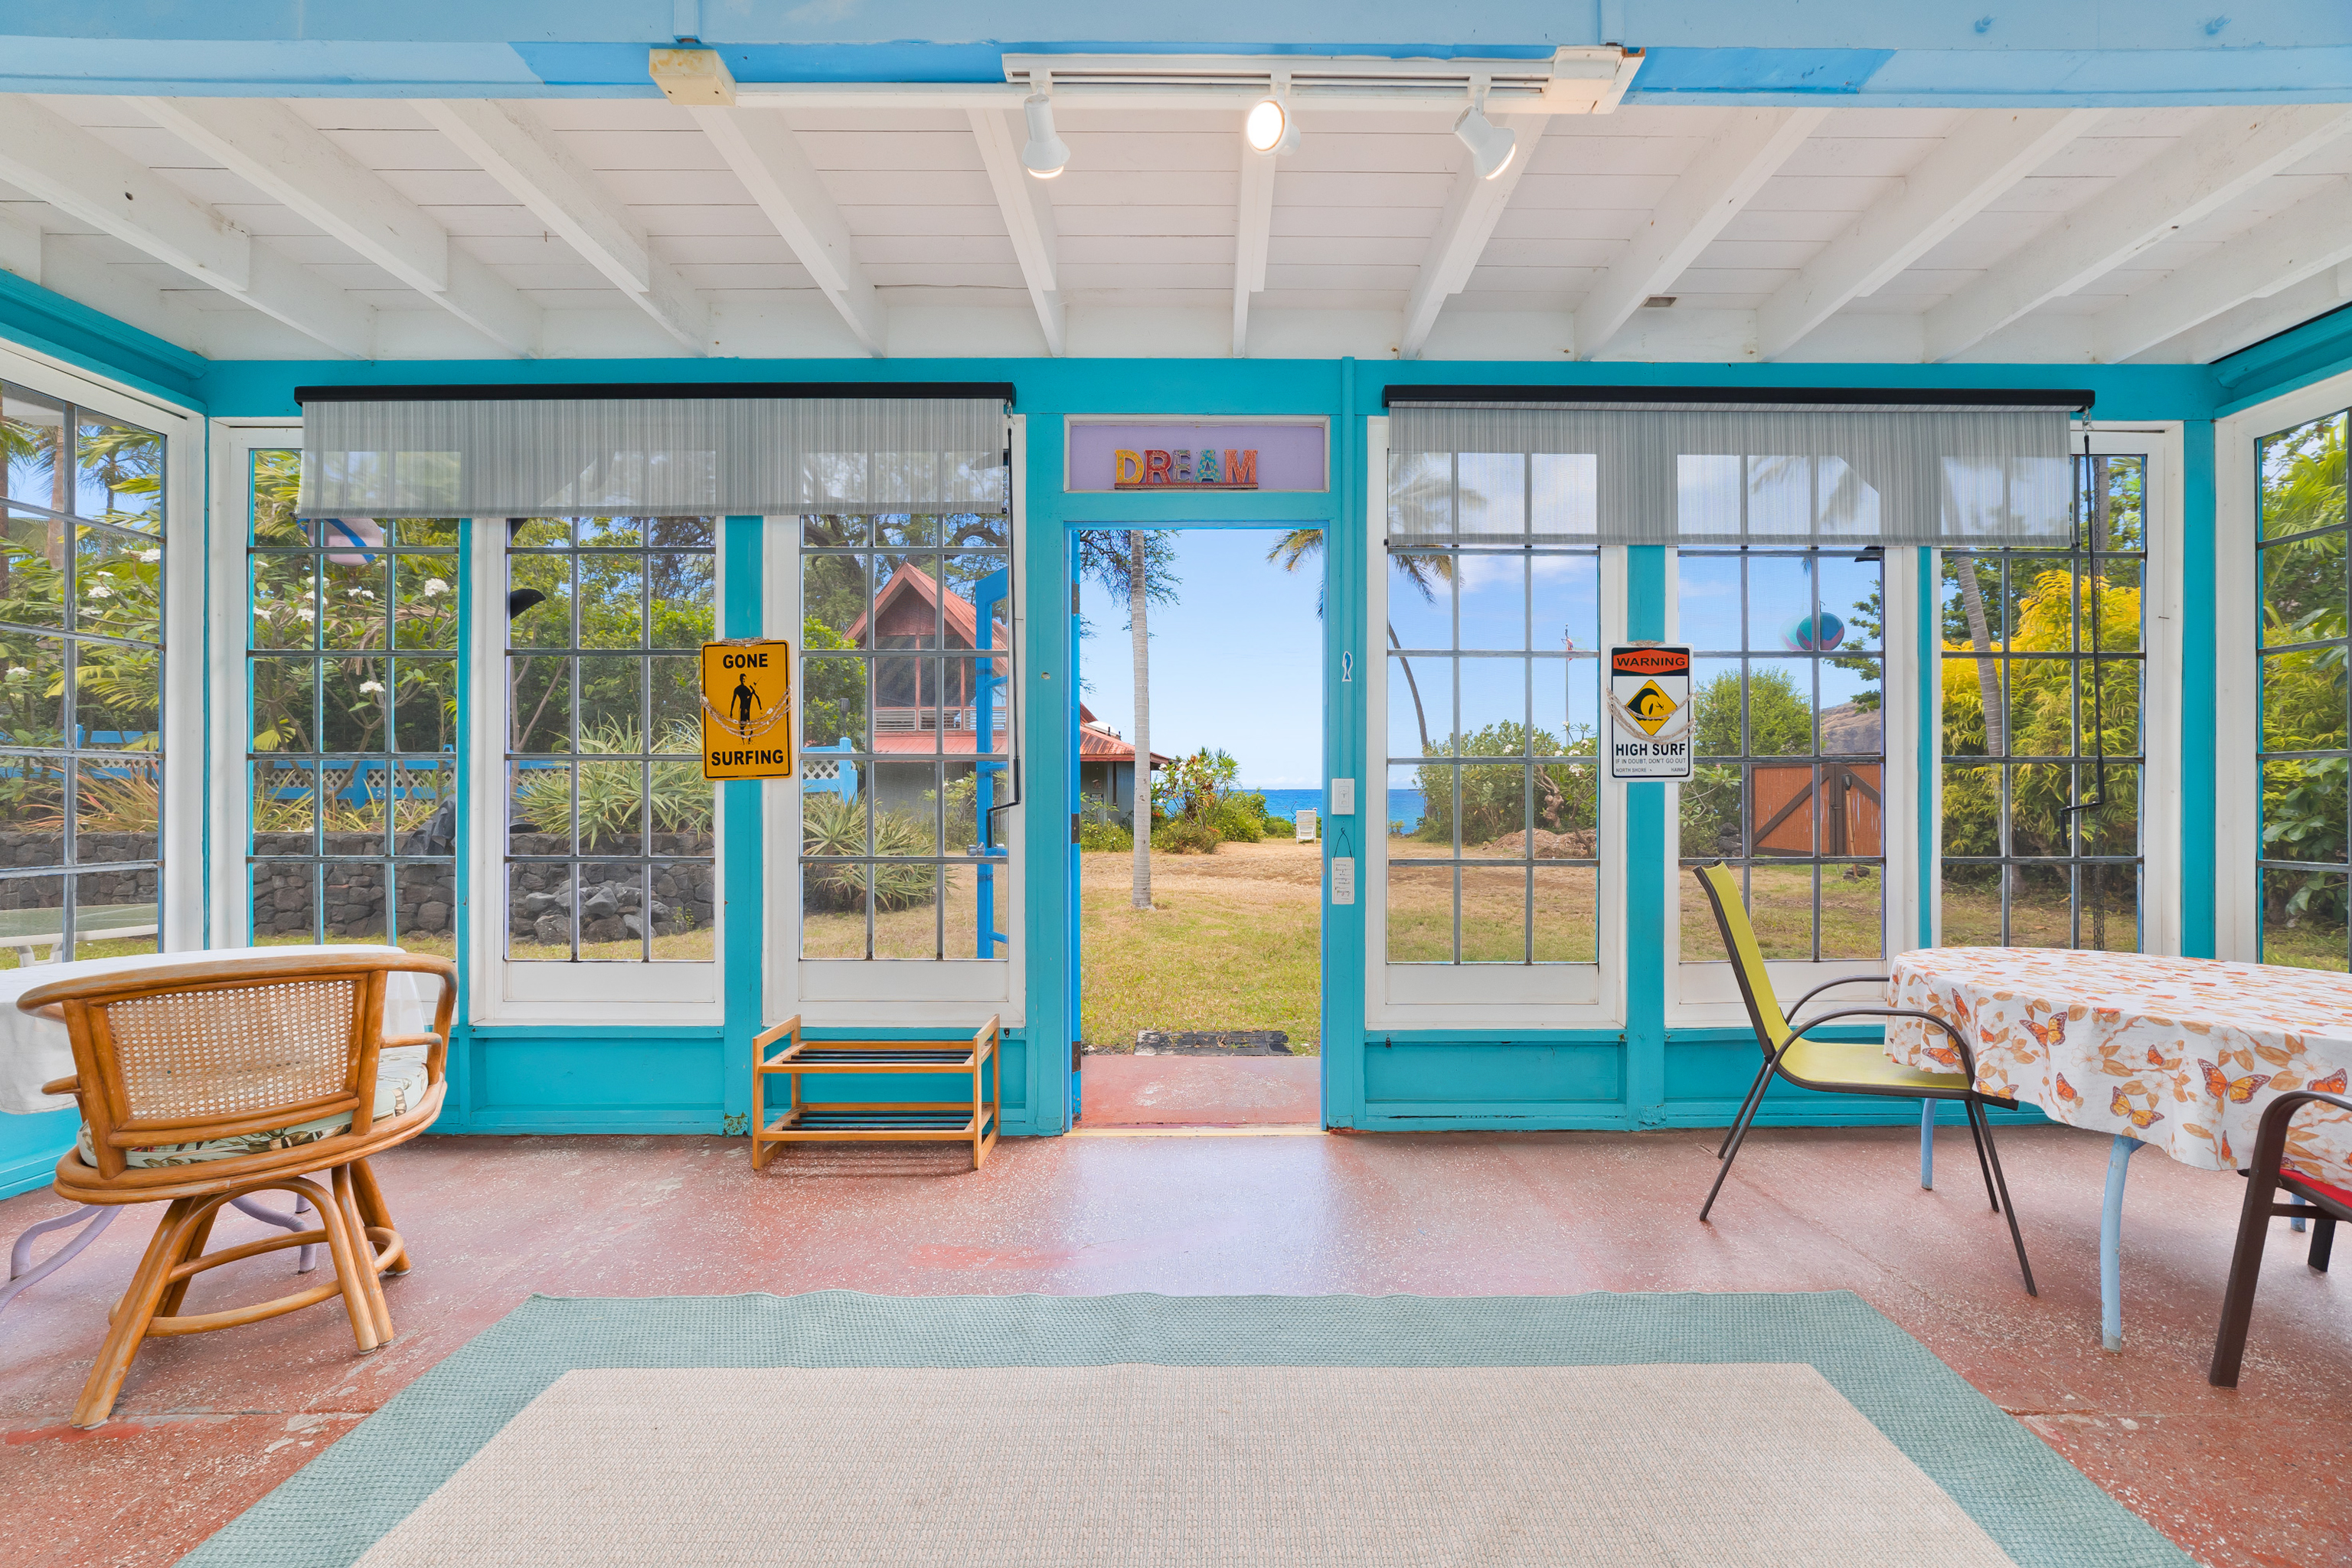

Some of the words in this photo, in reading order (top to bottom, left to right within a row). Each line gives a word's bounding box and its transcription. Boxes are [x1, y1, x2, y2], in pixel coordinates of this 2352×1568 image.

[1114, 449, 1259, 484] DREAM
[723, 653, 768, 669] GONE
[1616, 657, 1686, 667] WARNING
[711, 749, 784, 766] SURFING
[1615, 743, 1648, 756] HIGH
[1652, 743, 1686, 756] SURF
